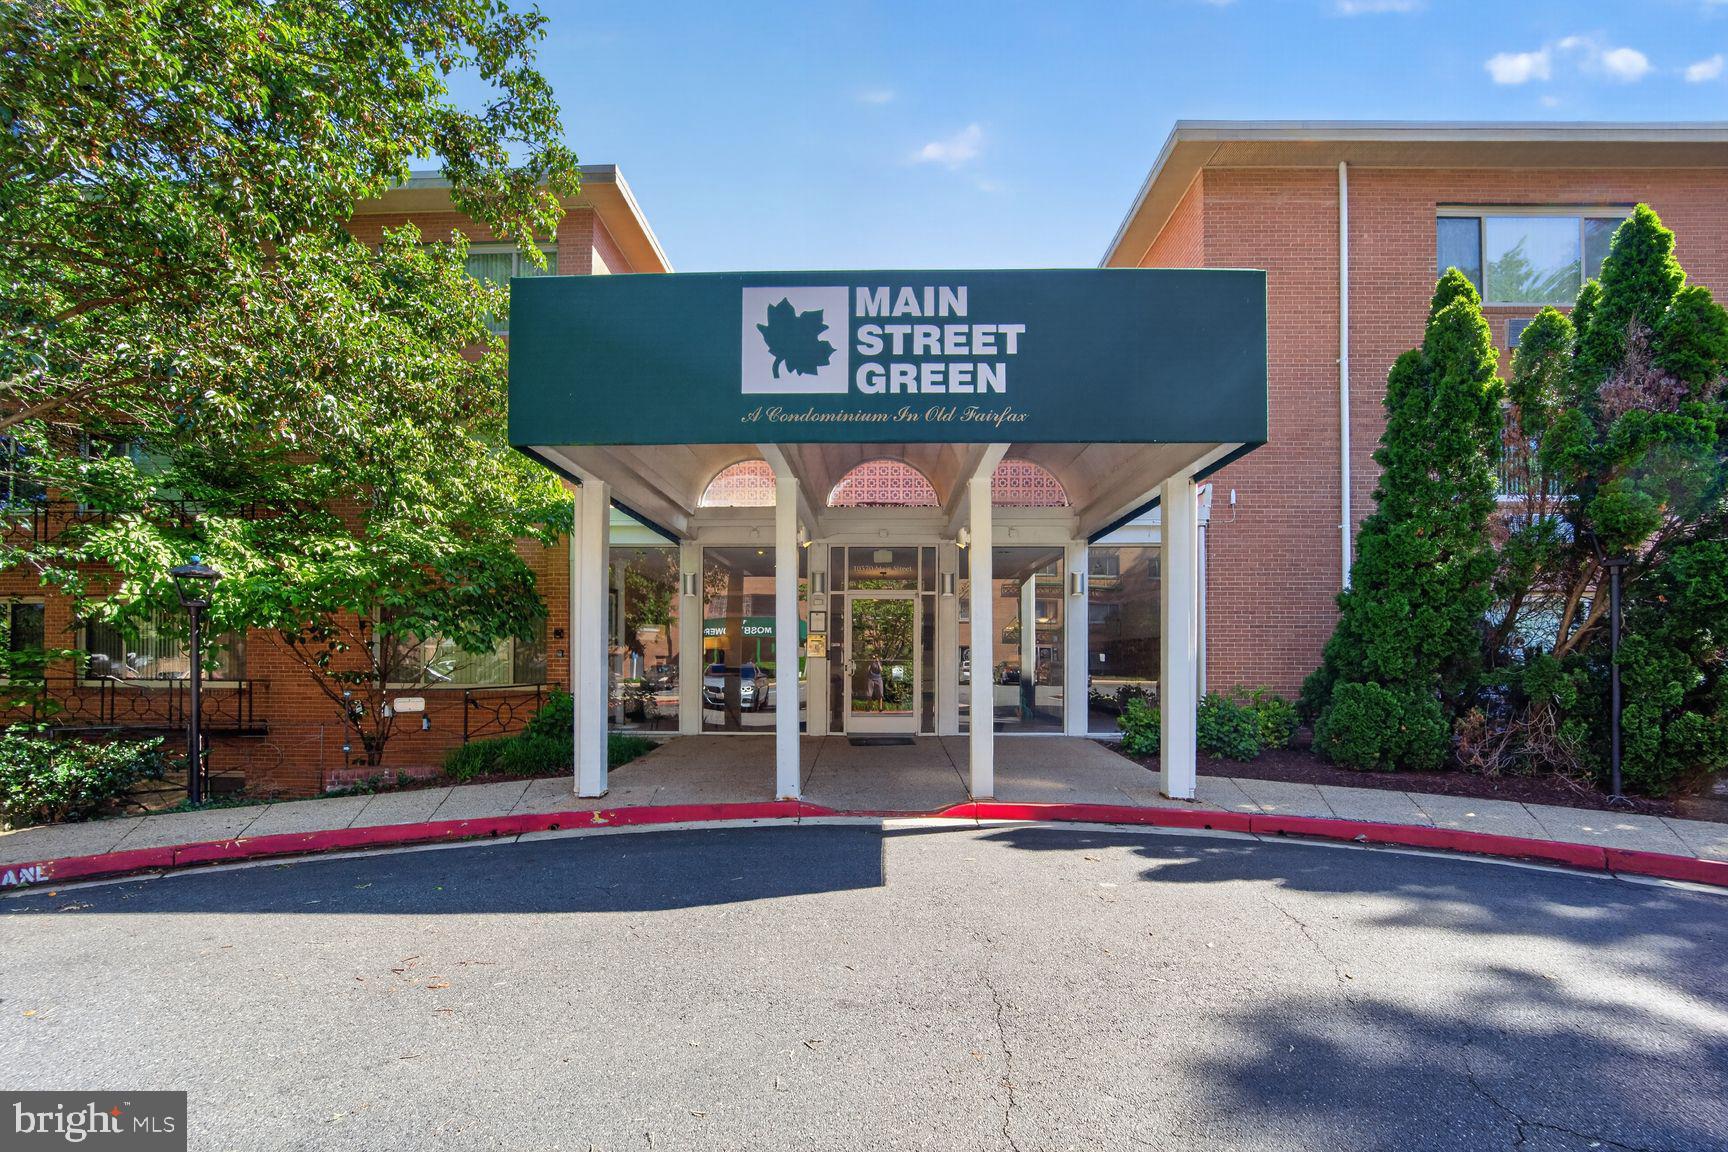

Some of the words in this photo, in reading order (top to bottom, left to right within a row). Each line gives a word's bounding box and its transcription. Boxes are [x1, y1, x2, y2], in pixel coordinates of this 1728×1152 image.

[856, 286, 968, 317] MAIN
[856, 323, 1026, 355] STREET
[856, 362, 1007, 394] GREEN
[741, 406, 762, 423] A
[765, 406, 889, 422] Condominium
[893, 405, 919, 422] In
[925, 405, 957, 422] Old
[960, 405, 1029, 428] Fairfax
